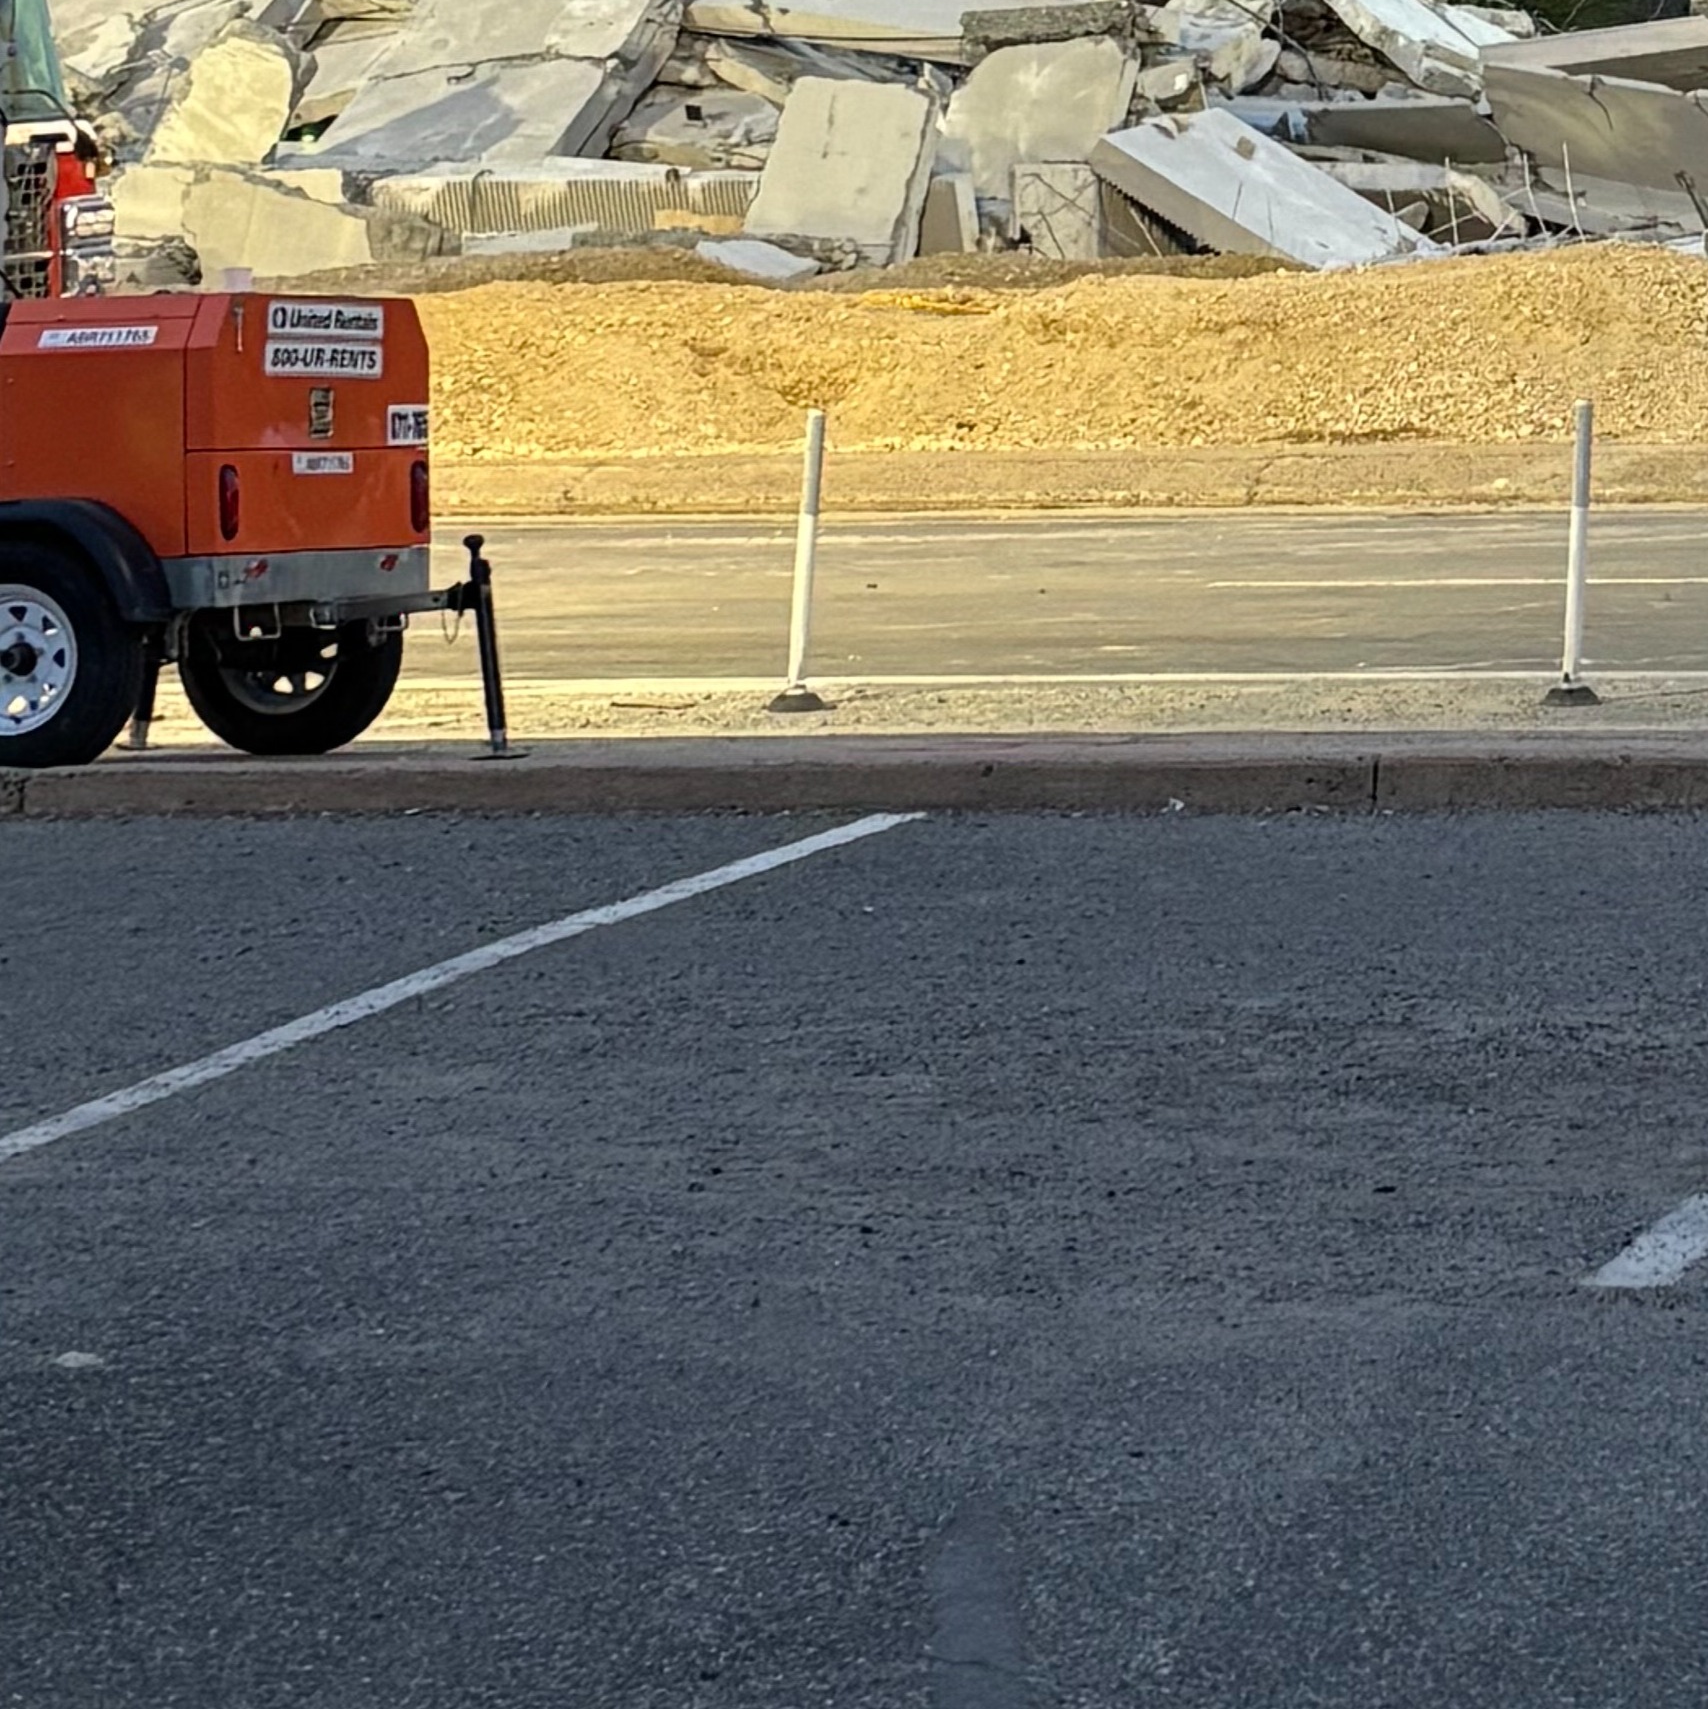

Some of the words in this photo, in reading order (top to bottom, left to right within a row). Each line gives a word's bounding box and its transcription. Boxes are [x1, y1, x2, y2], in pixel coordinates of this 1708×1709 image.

[290, 308, 332, 329] United
[334, 310, 378, 331] Rentals
[271, 347, 378, 371] 800-UR-RENTS
